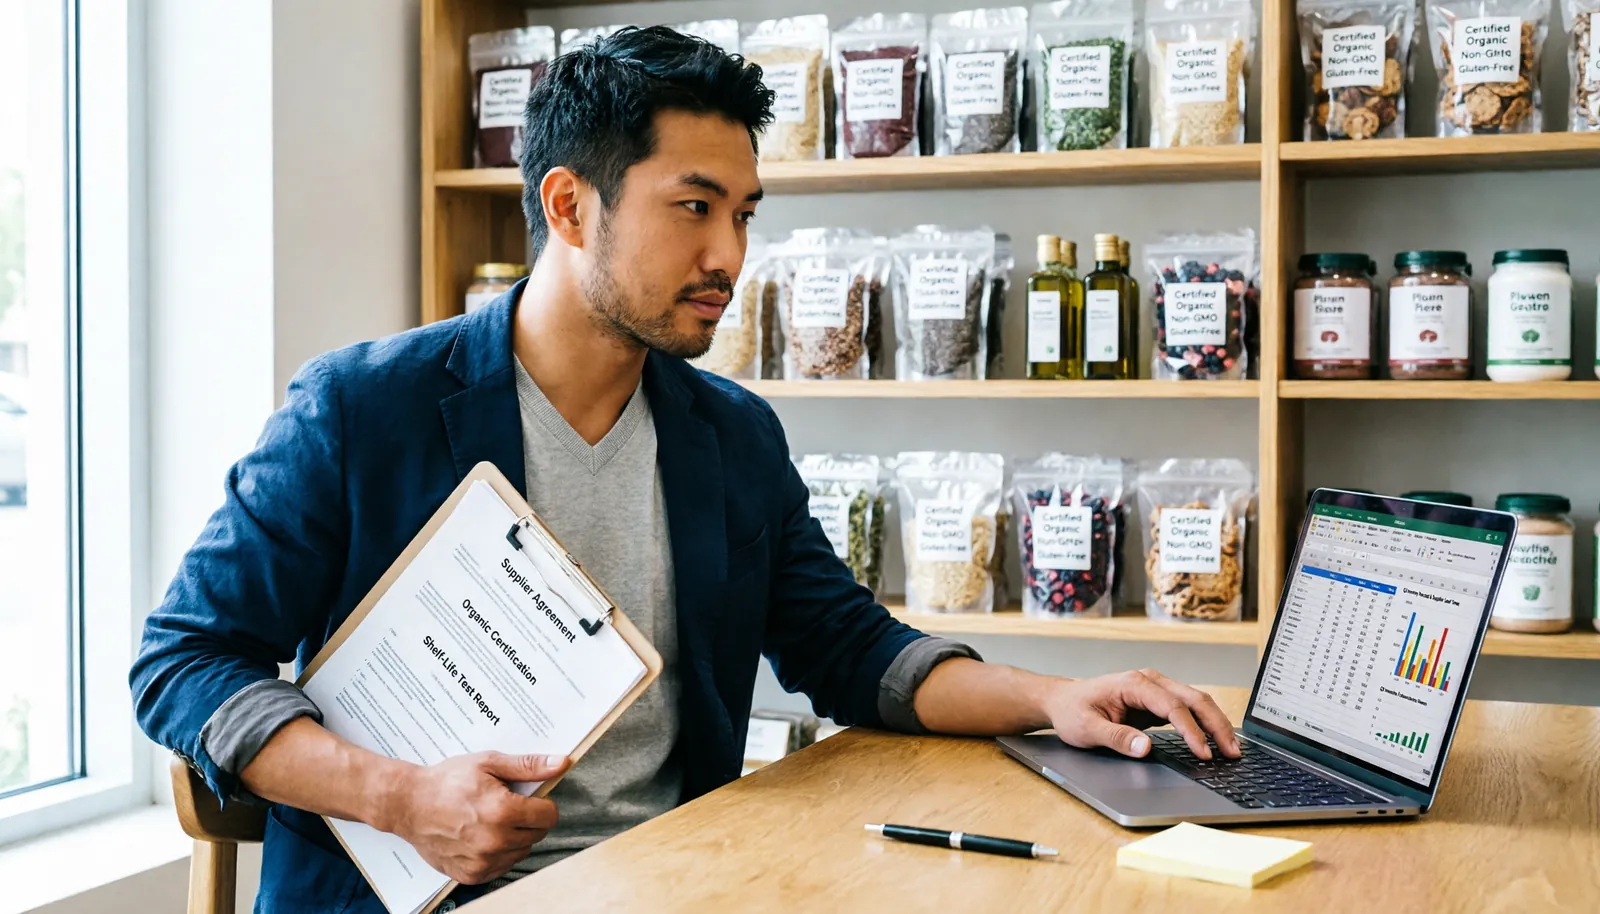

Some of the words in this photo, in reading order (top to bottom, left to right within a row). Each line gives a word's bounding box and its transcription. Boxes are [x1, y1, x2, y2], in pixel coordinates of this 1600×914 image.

[1465, 24, 1511, 34] Certified
[1333, 32, 1376, 42] Certified
[1466, 35, 1508, 47] Organic
[1176, 48, 1216, 57] Certified
[1333, 43, 1374, 53] Organic
[1060, 52, 1101, 62] Certified
[1328, 55, 1377, 65] Non-GMO
[956, 60, 995, 69] Certified
[1061, 64, 1098, 74] Organic
[1177, 60, 1215, 69] Organic
[1458, 63, 1515, 73] Gluten-Free
[1174, 289, 1216, 299] Certified
[1176, 301, 1214, 312] Organic
[1171, 313, 1218, 323] Non-GMO
[1042, 512, 1082, 522] Certified
[1170, 516, 1211, 525] Certified
[1043, 524, 1080, 535] Organic
[1171, 526, 1209, 538] Organic
[501, 558, 535, 596] Supplier
[531, 593, 576, 644] Agreement
[462, 599, 492, 634] Organic
[490, 630, 537, 686] Certification
[423, 635, 458, 678] Shelf-Life
[457, 673, 475, 697] Test
[472, 692, 500, 726] Report
